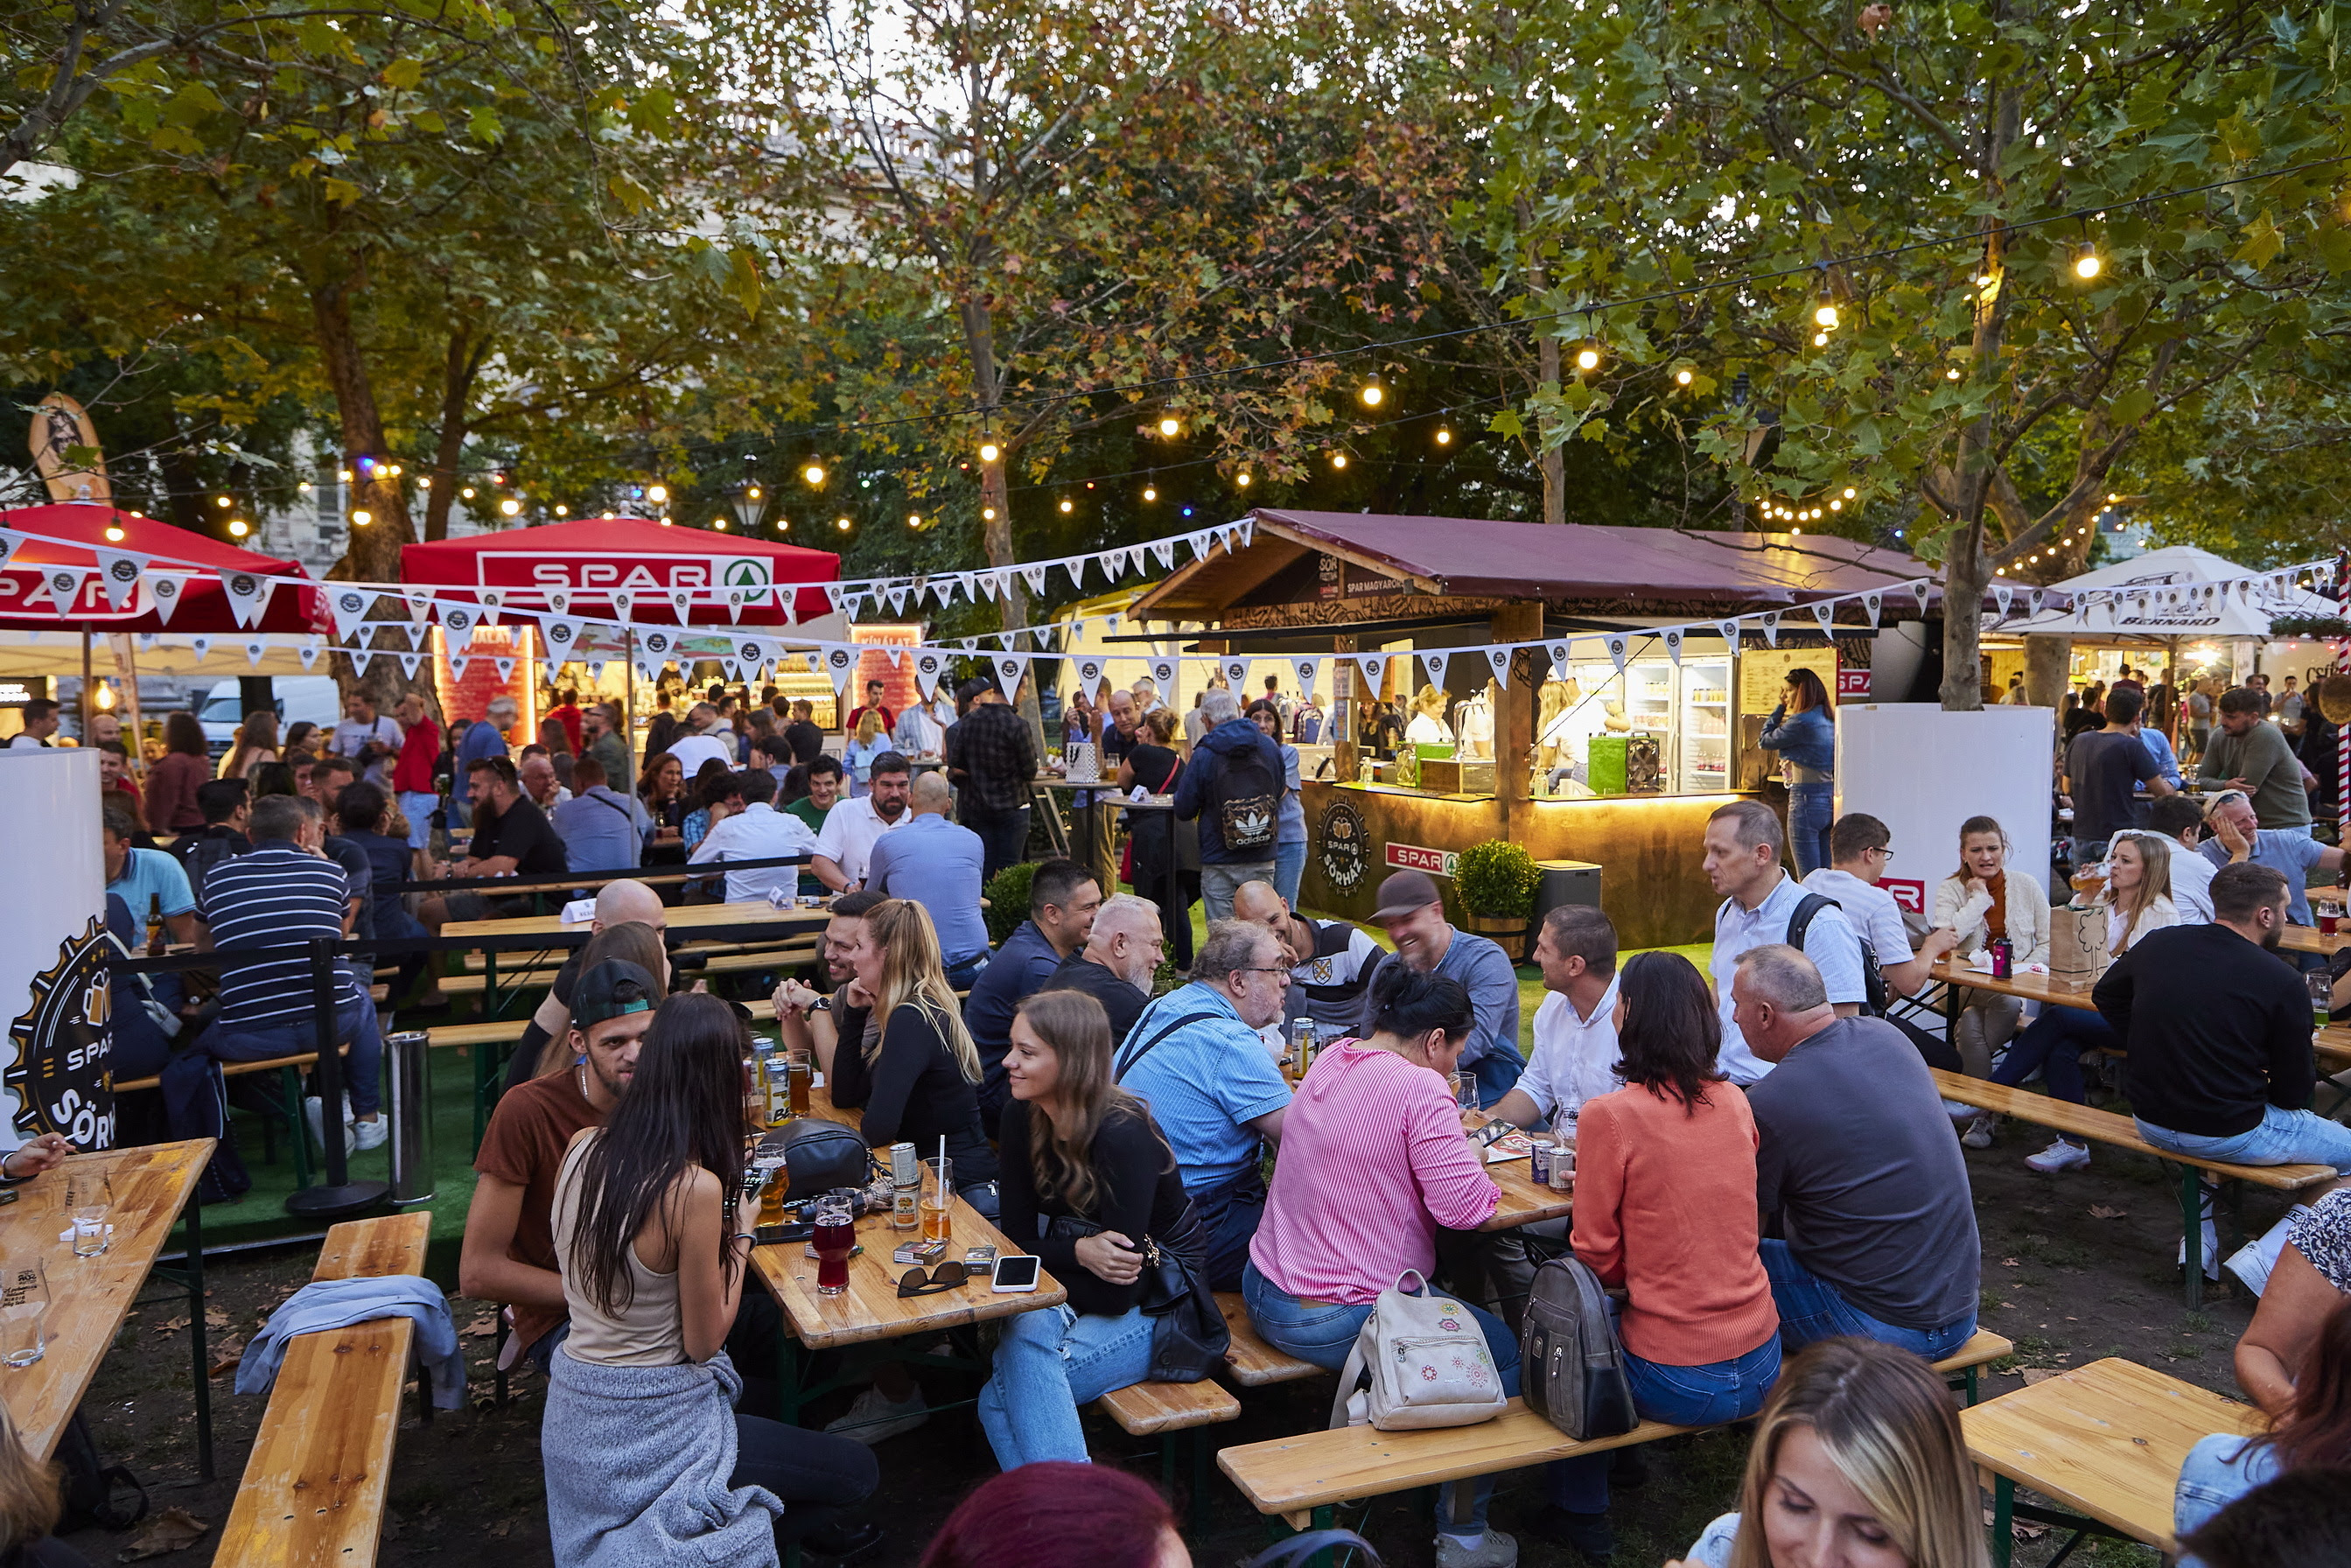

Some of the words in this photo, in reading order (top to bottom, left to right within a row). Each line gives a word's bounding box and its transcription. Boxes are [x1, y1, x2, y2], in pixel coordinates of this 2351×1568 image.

[533, 564, 707, 588] SPAR
[2120, 617, 2221, 626] BERNARD
[1236, 834, 1270, 845] adidas
[1327, 841, 1350, 853] SPAR
[1397, 849, 1441, 869] SPAR
